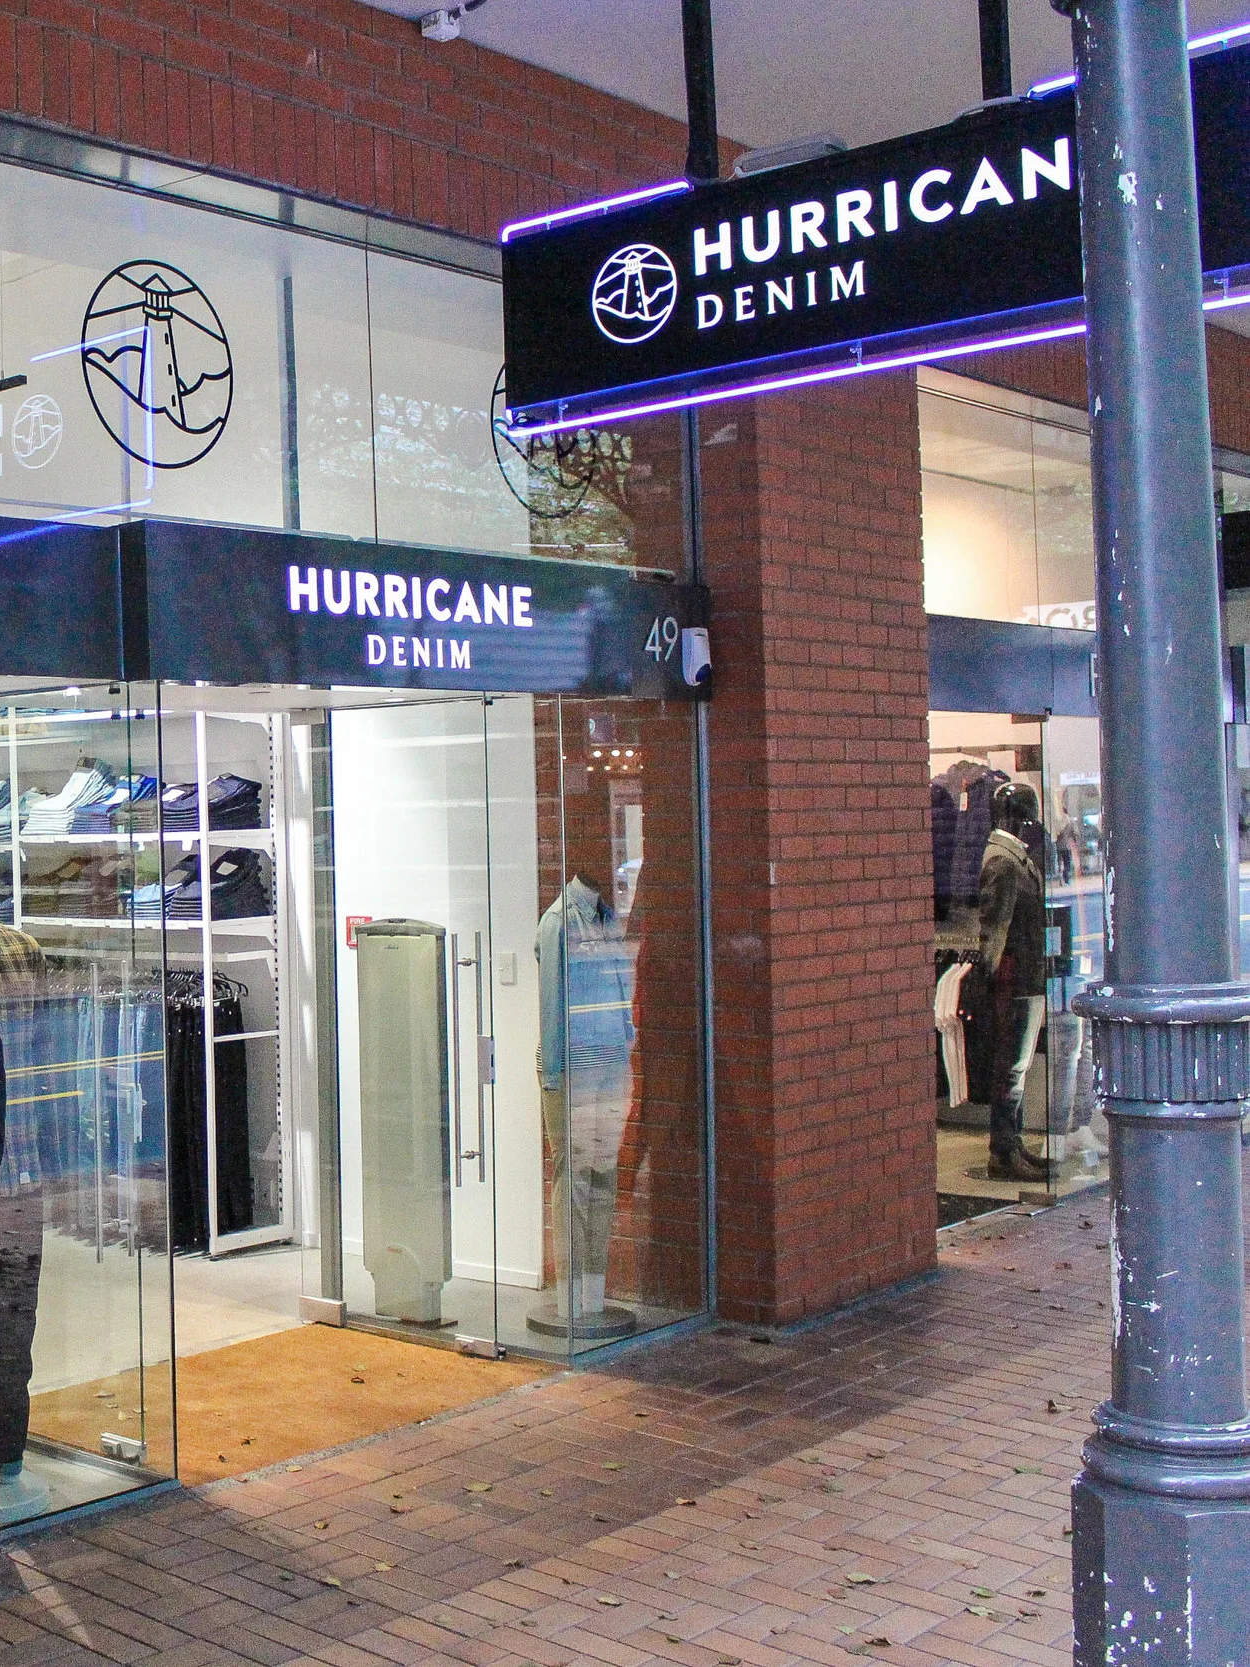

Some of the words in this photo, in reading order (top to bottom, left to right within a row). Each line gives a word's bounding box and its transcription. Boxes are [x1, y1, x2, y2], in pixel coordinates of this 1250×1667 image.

[696, 260, 866, 330] DENIM
[287, 565, 534, 628] HURRICANE
[366, 633, 471, 670] DENIM
[644, 616, 679, 662] 49
[349, 917, 366, 925] FIRE
